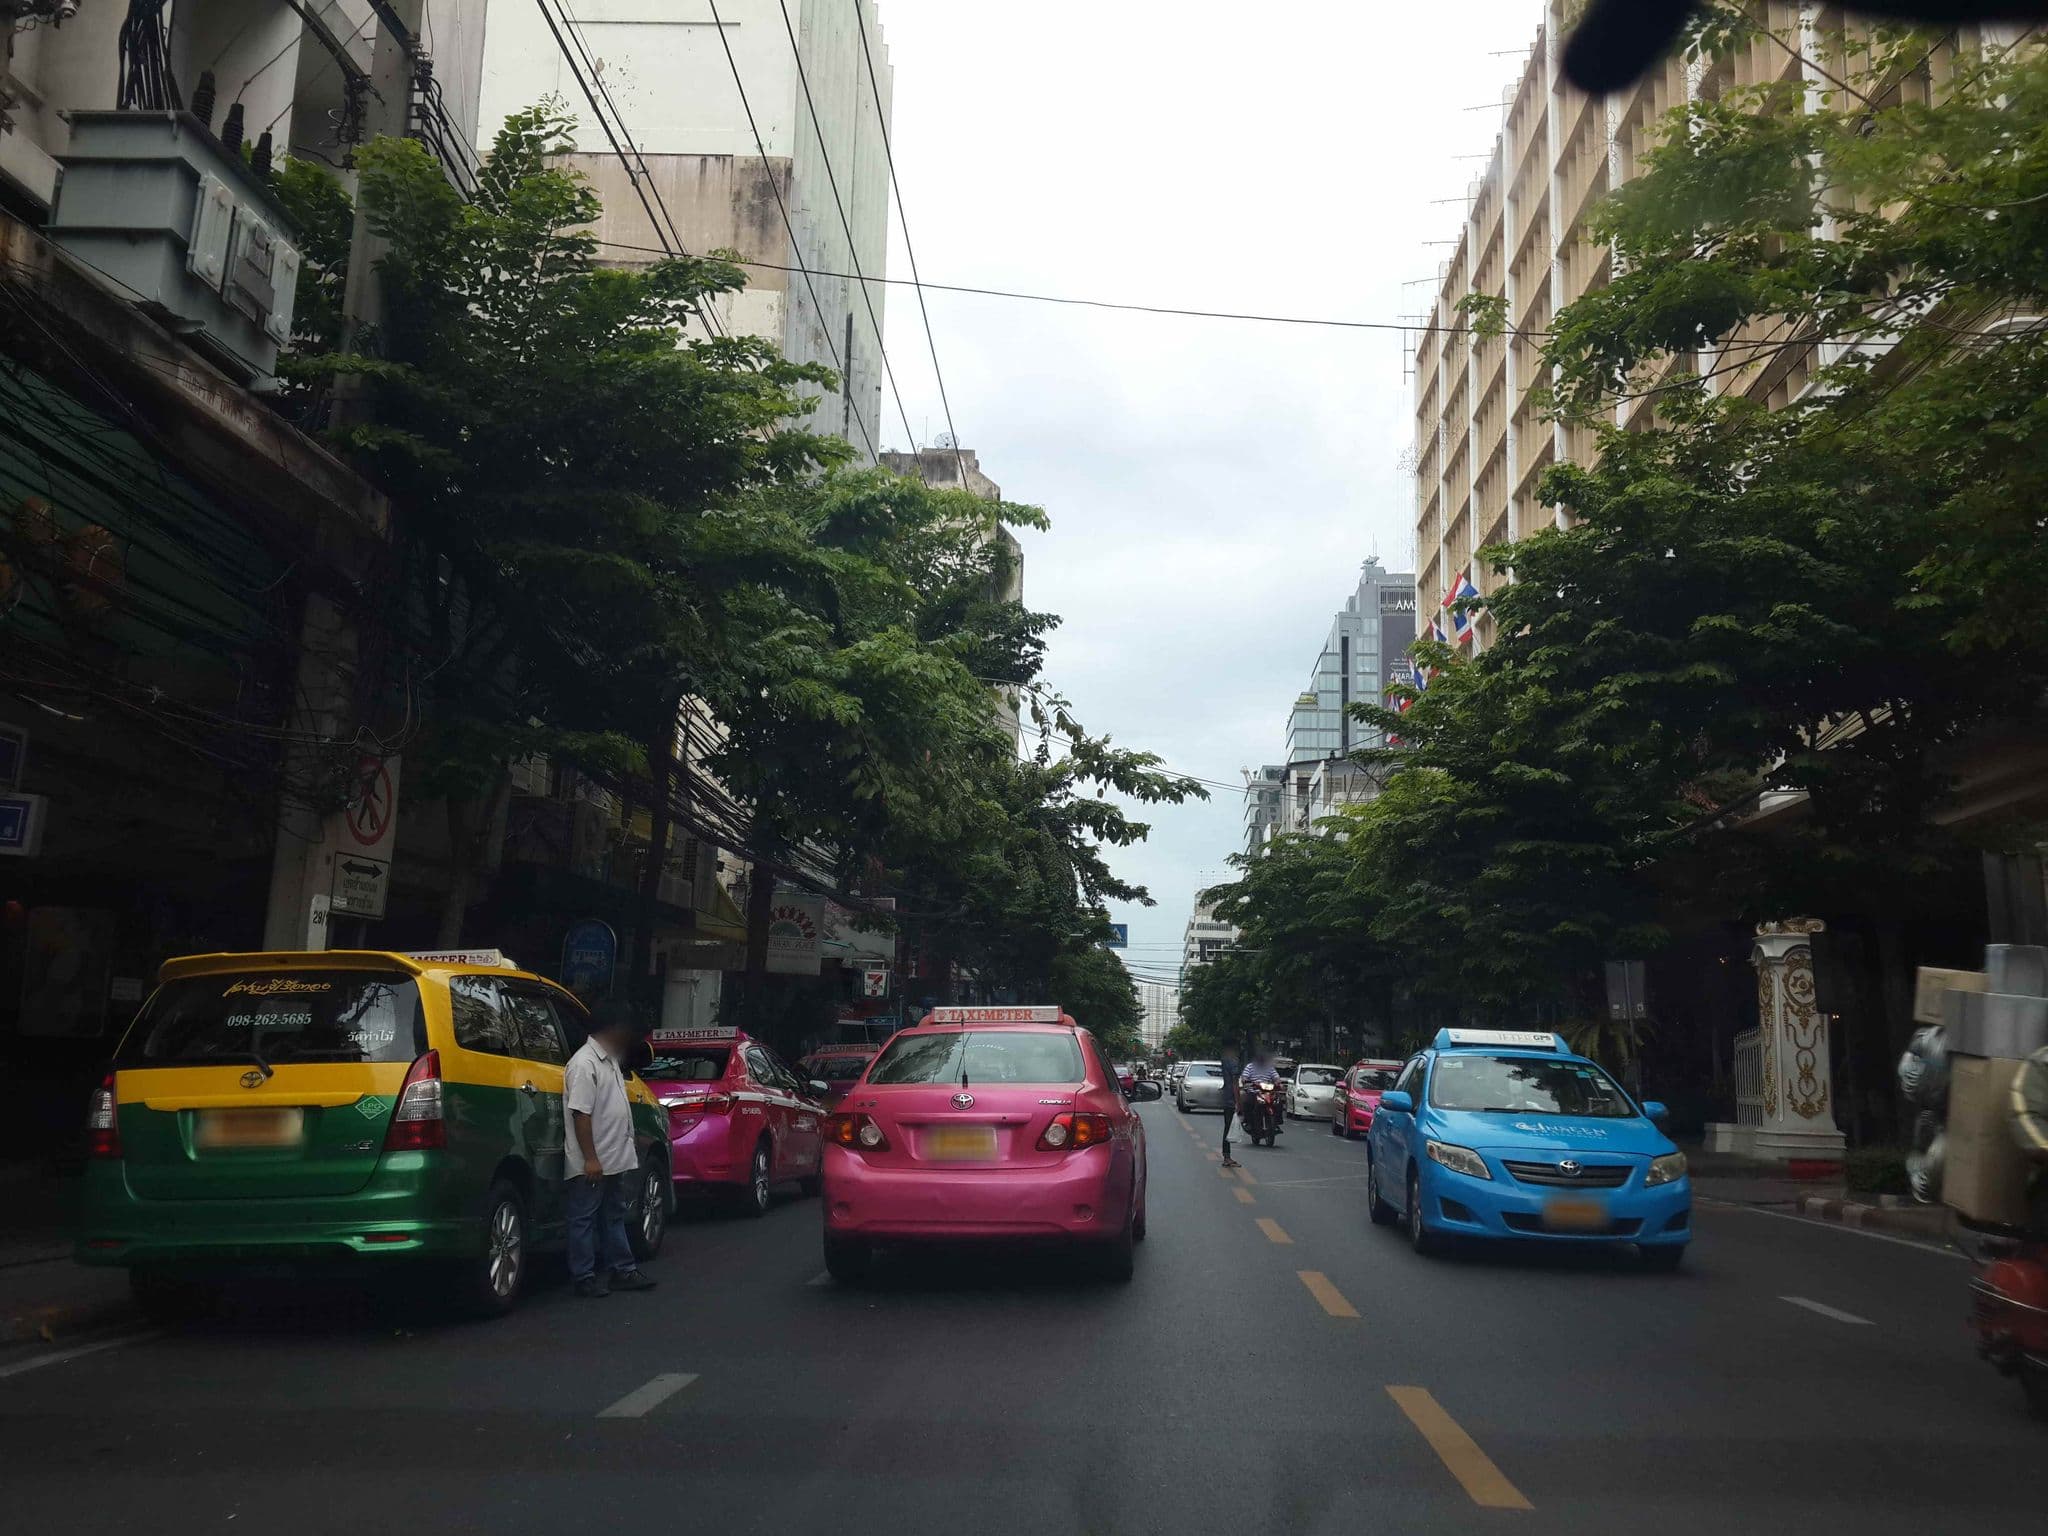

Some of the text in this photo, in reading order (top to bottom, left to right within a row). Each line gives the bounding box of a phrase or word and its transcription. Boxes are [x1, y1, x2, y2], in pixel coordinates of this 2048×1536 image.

[226, 1012, 312, 1027] 098-262-5685
[948, 1009, 1032, 1021] TAXI-METER
[347, 1029, 395, 1042] วัดท่าไม้
[664, 1029, 719, 1039] TAXI-METER
